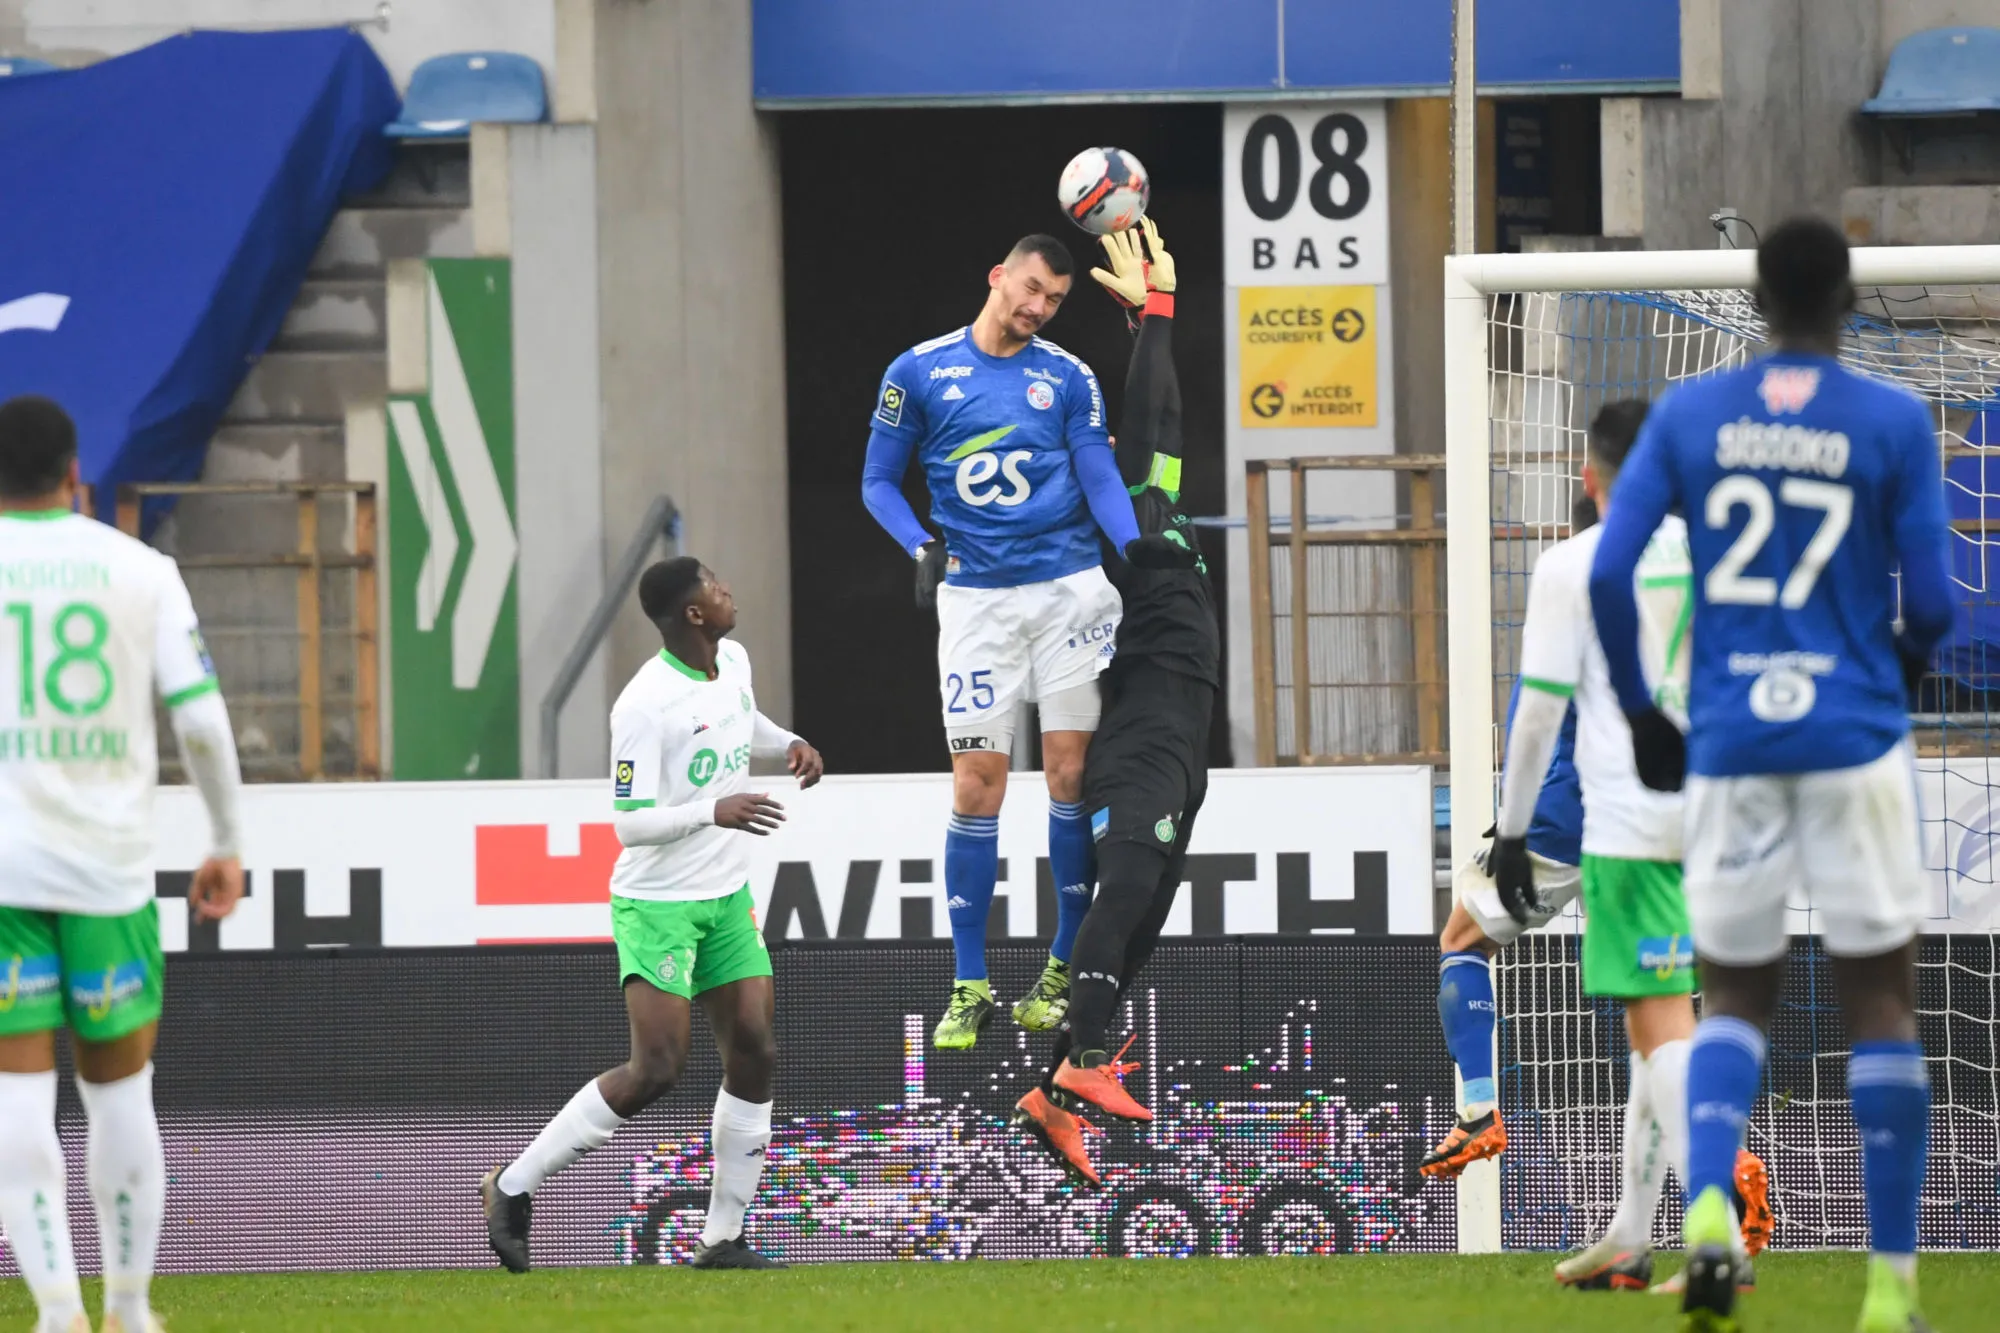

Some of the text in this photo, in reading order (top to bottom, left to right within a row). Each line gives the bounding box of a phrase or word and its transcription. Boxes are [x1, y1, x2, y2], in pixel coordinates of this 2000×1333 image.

[1241, 112, 1371, 221] 08
[1253, 236, 1360, 270] BAS
[1247, 331, 1325, 344] COURSIVE
[1249, 305, 1323, 326] ACCÈS
[1290, 402, 1364, 416] INTERDIT
[955, 450, 1033, 506] es
[1704, 473, 1855, 610] 27
[6, 602, 115, 718] 18
[947, 669, 995, 714] 25
